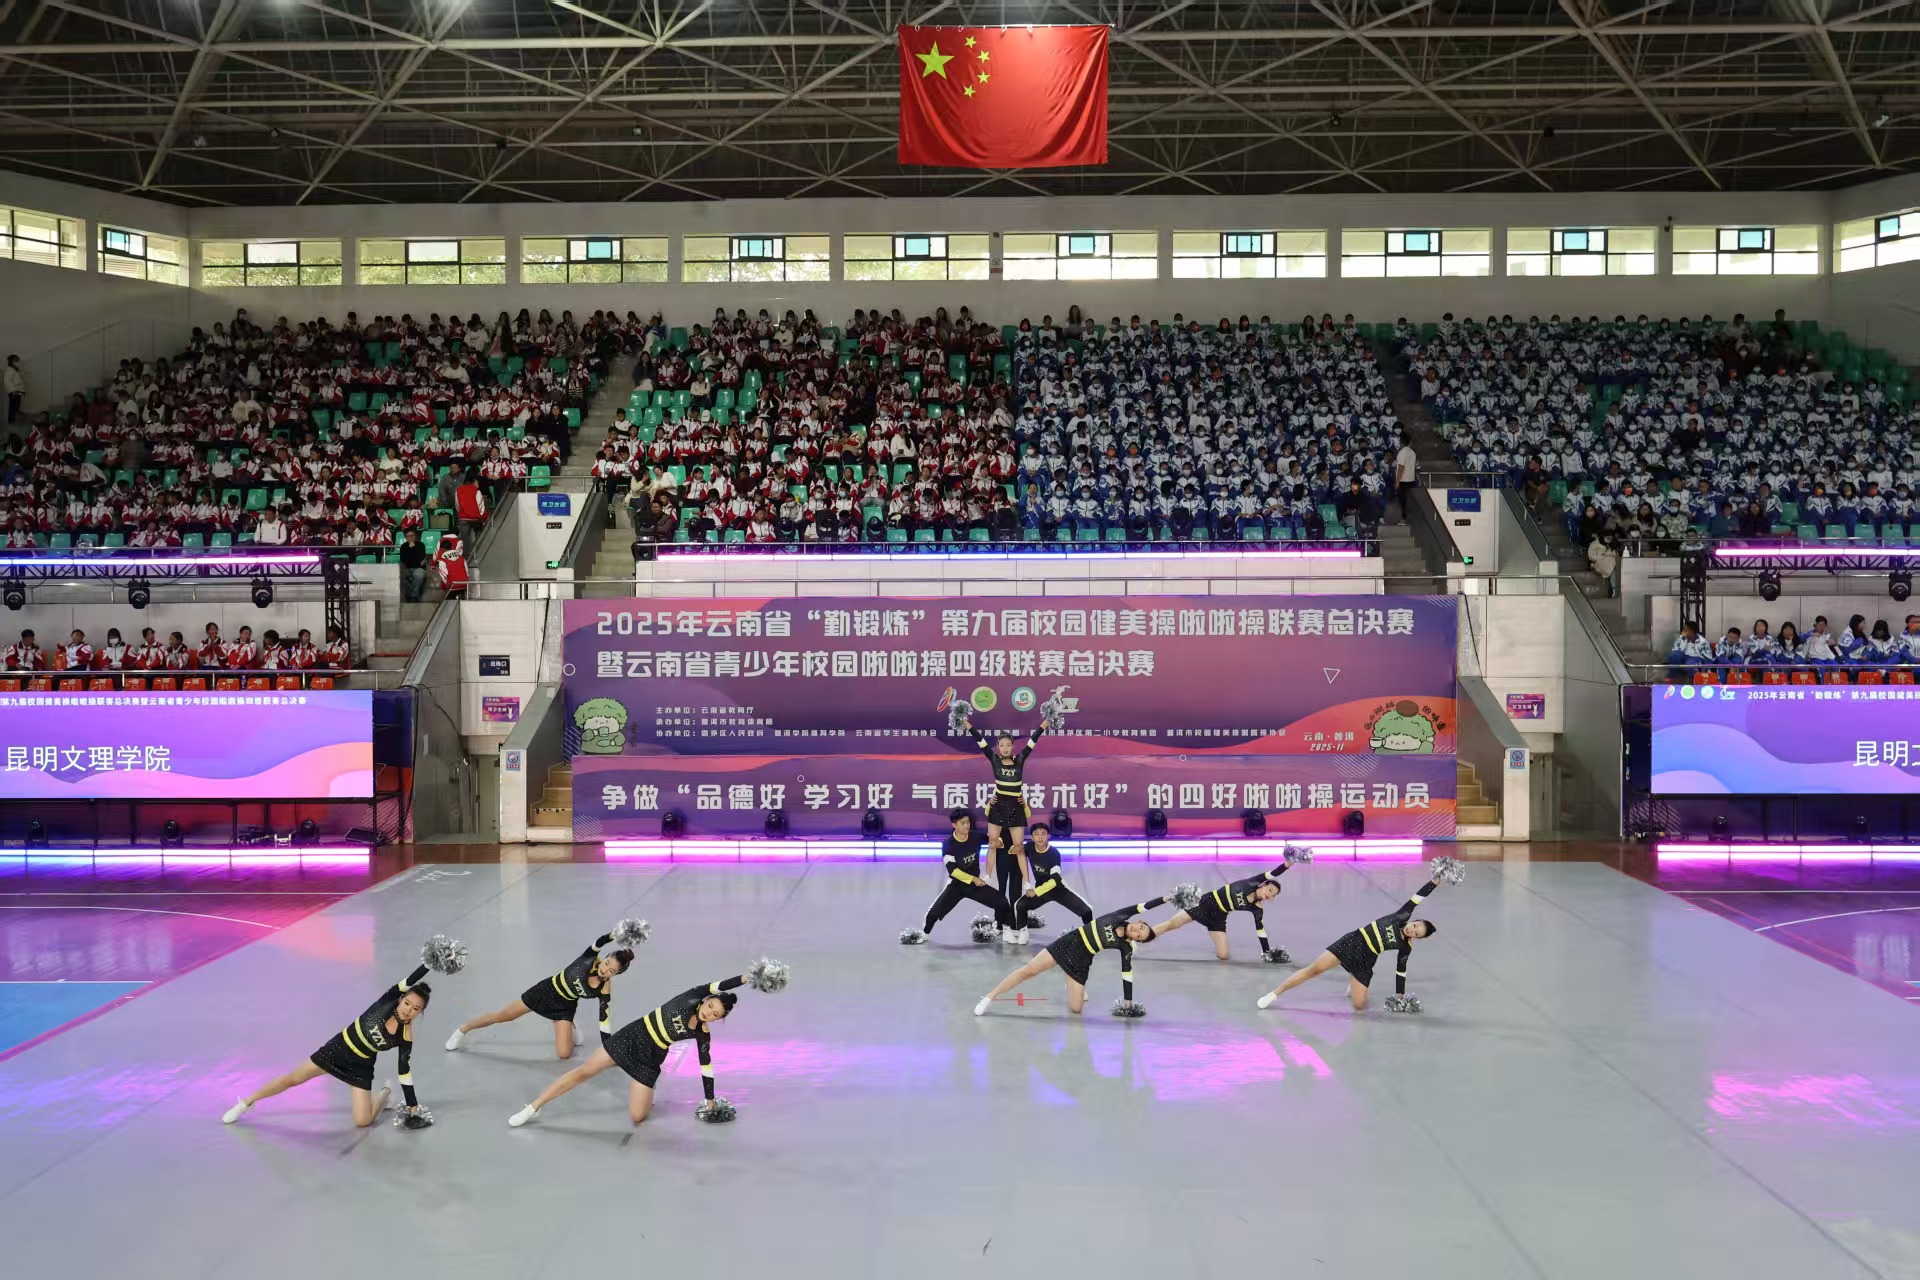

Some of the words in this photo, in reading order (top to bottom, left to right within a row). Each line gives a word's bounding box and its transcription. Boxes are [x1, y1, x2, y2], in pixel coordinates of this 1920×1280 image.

[596, 649, 1155, 678] 暨云南省青少年校园啦啦操四级联赛总决赛
[4, 745, 171, 773] 昆明文理学院
[1001, 768, 1016, 776] YZY
[803, 784, 894, 810] 学习好
